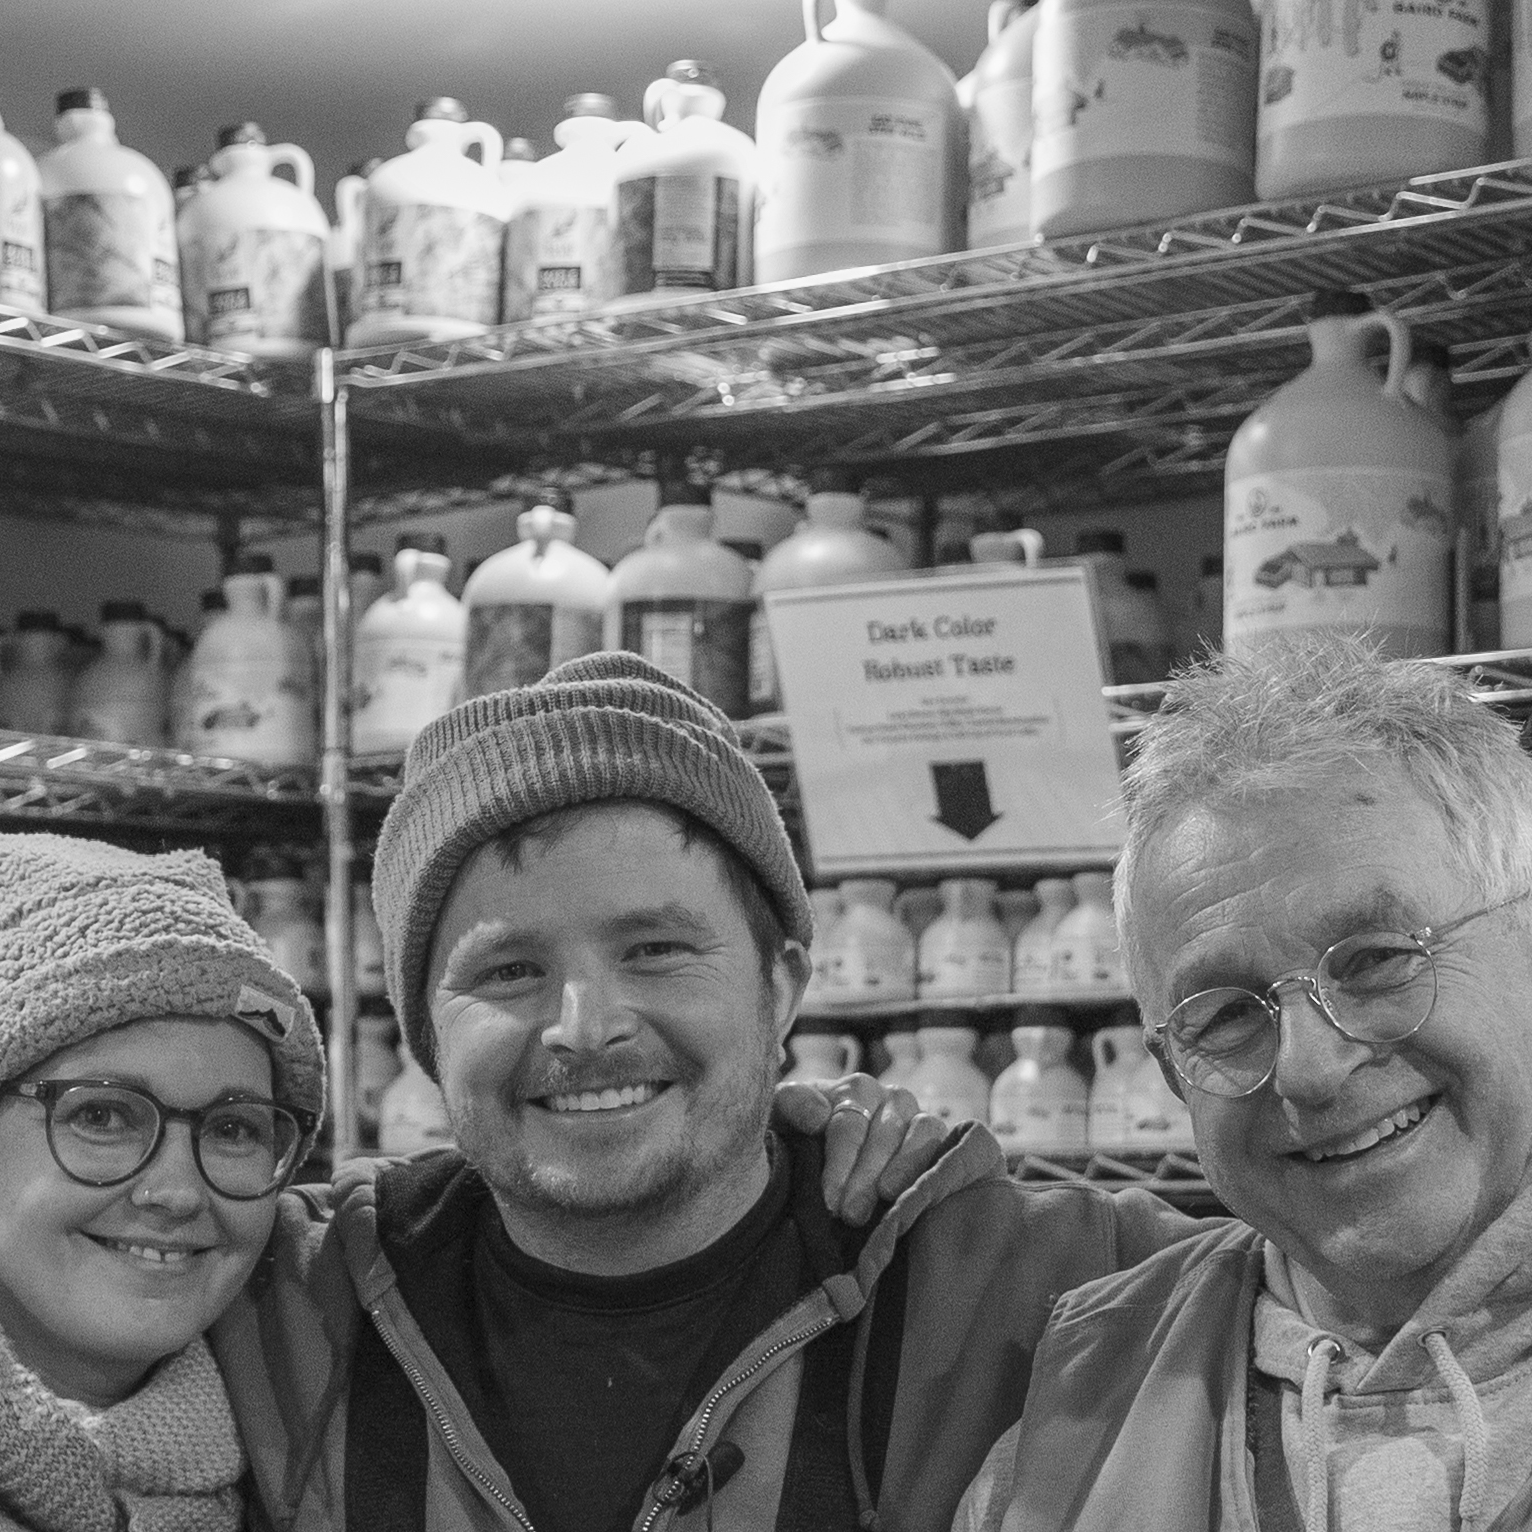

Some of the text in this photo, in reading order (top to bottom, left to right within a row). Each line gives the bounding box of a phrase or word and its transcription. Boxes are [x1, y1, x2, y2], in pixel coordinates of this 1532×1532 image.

[867, 615, 997, 644] Dark Color
[863, 653, 1015, 683] Robust Taste
